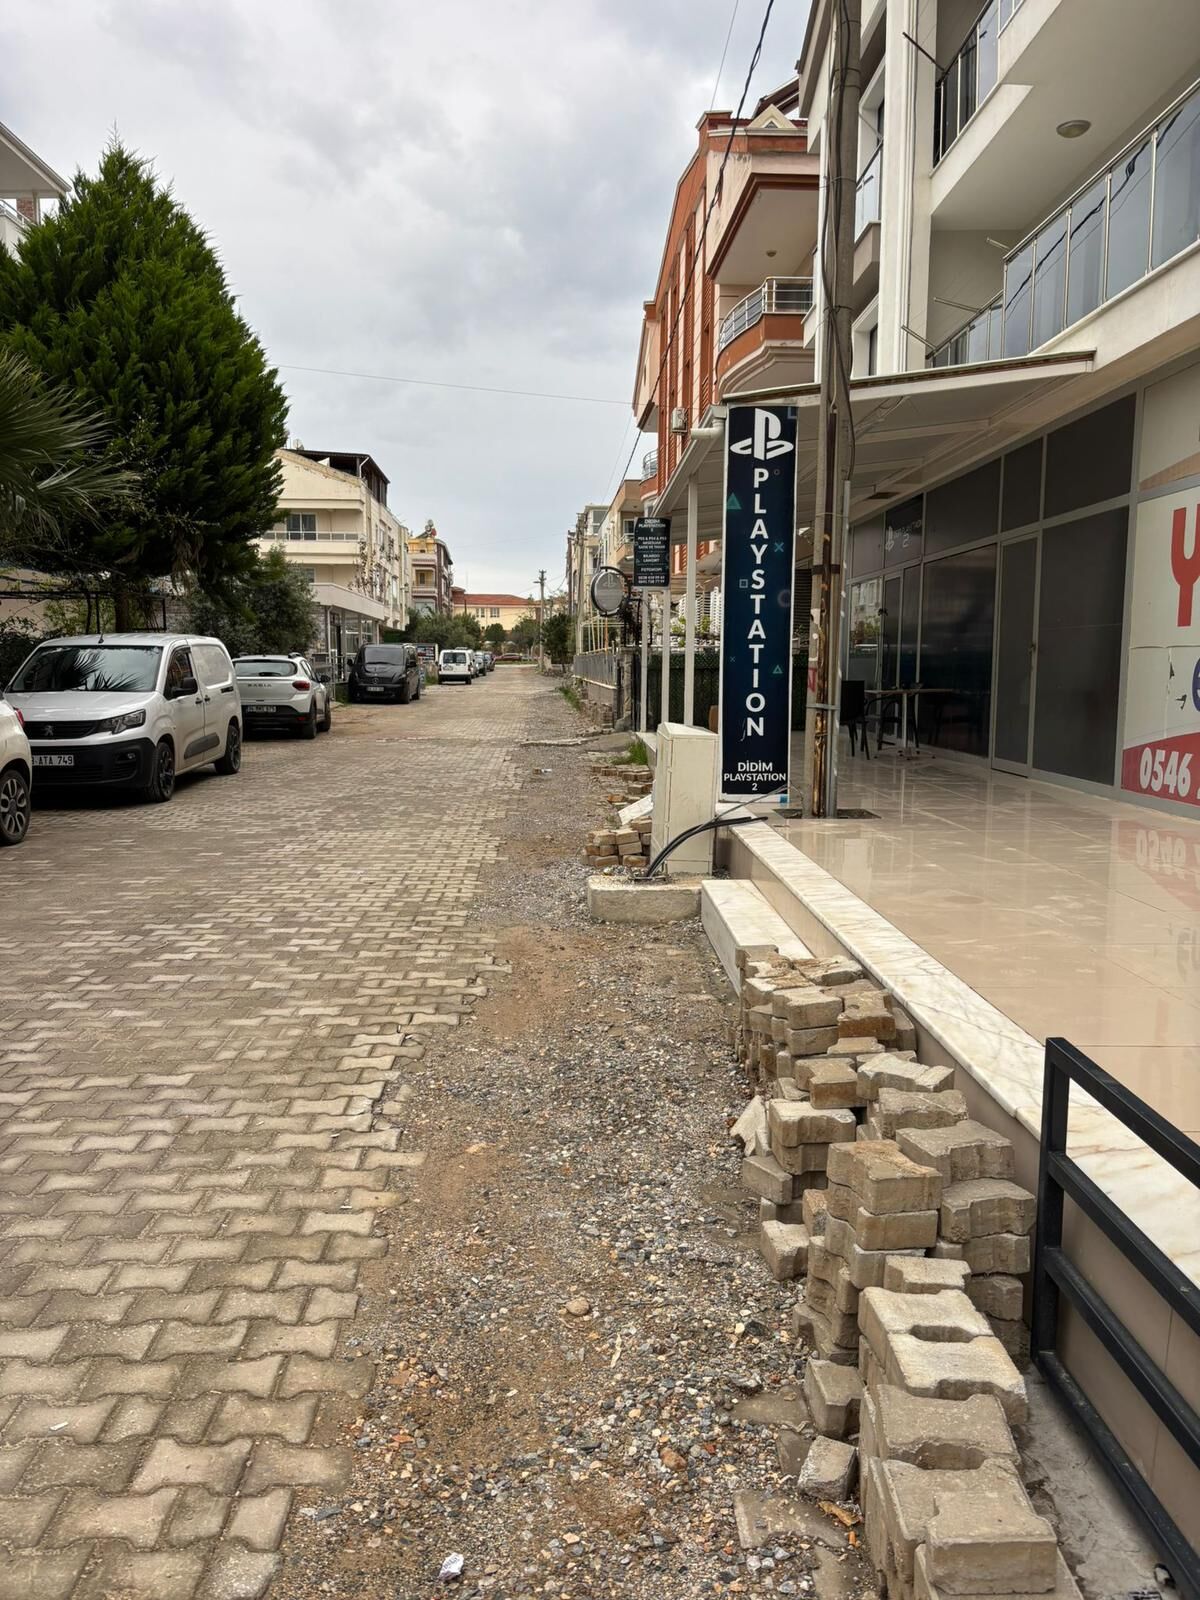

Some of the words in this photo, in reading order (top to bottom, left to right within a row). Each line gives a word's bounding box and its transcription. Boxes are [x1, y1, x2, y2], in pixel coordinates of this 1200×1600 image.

[746, 468, 769, 736] PLAYSTATION
[38, 755, 54, 766] ATA
[57, 755, 73, 766] 749
[737, 759, 773, 772] DİDİM
[723, 772, 787, 782] PLAYSTATION
[1140, 747, 1194, 797] 0546
[751, 782, 759, 791] 2
